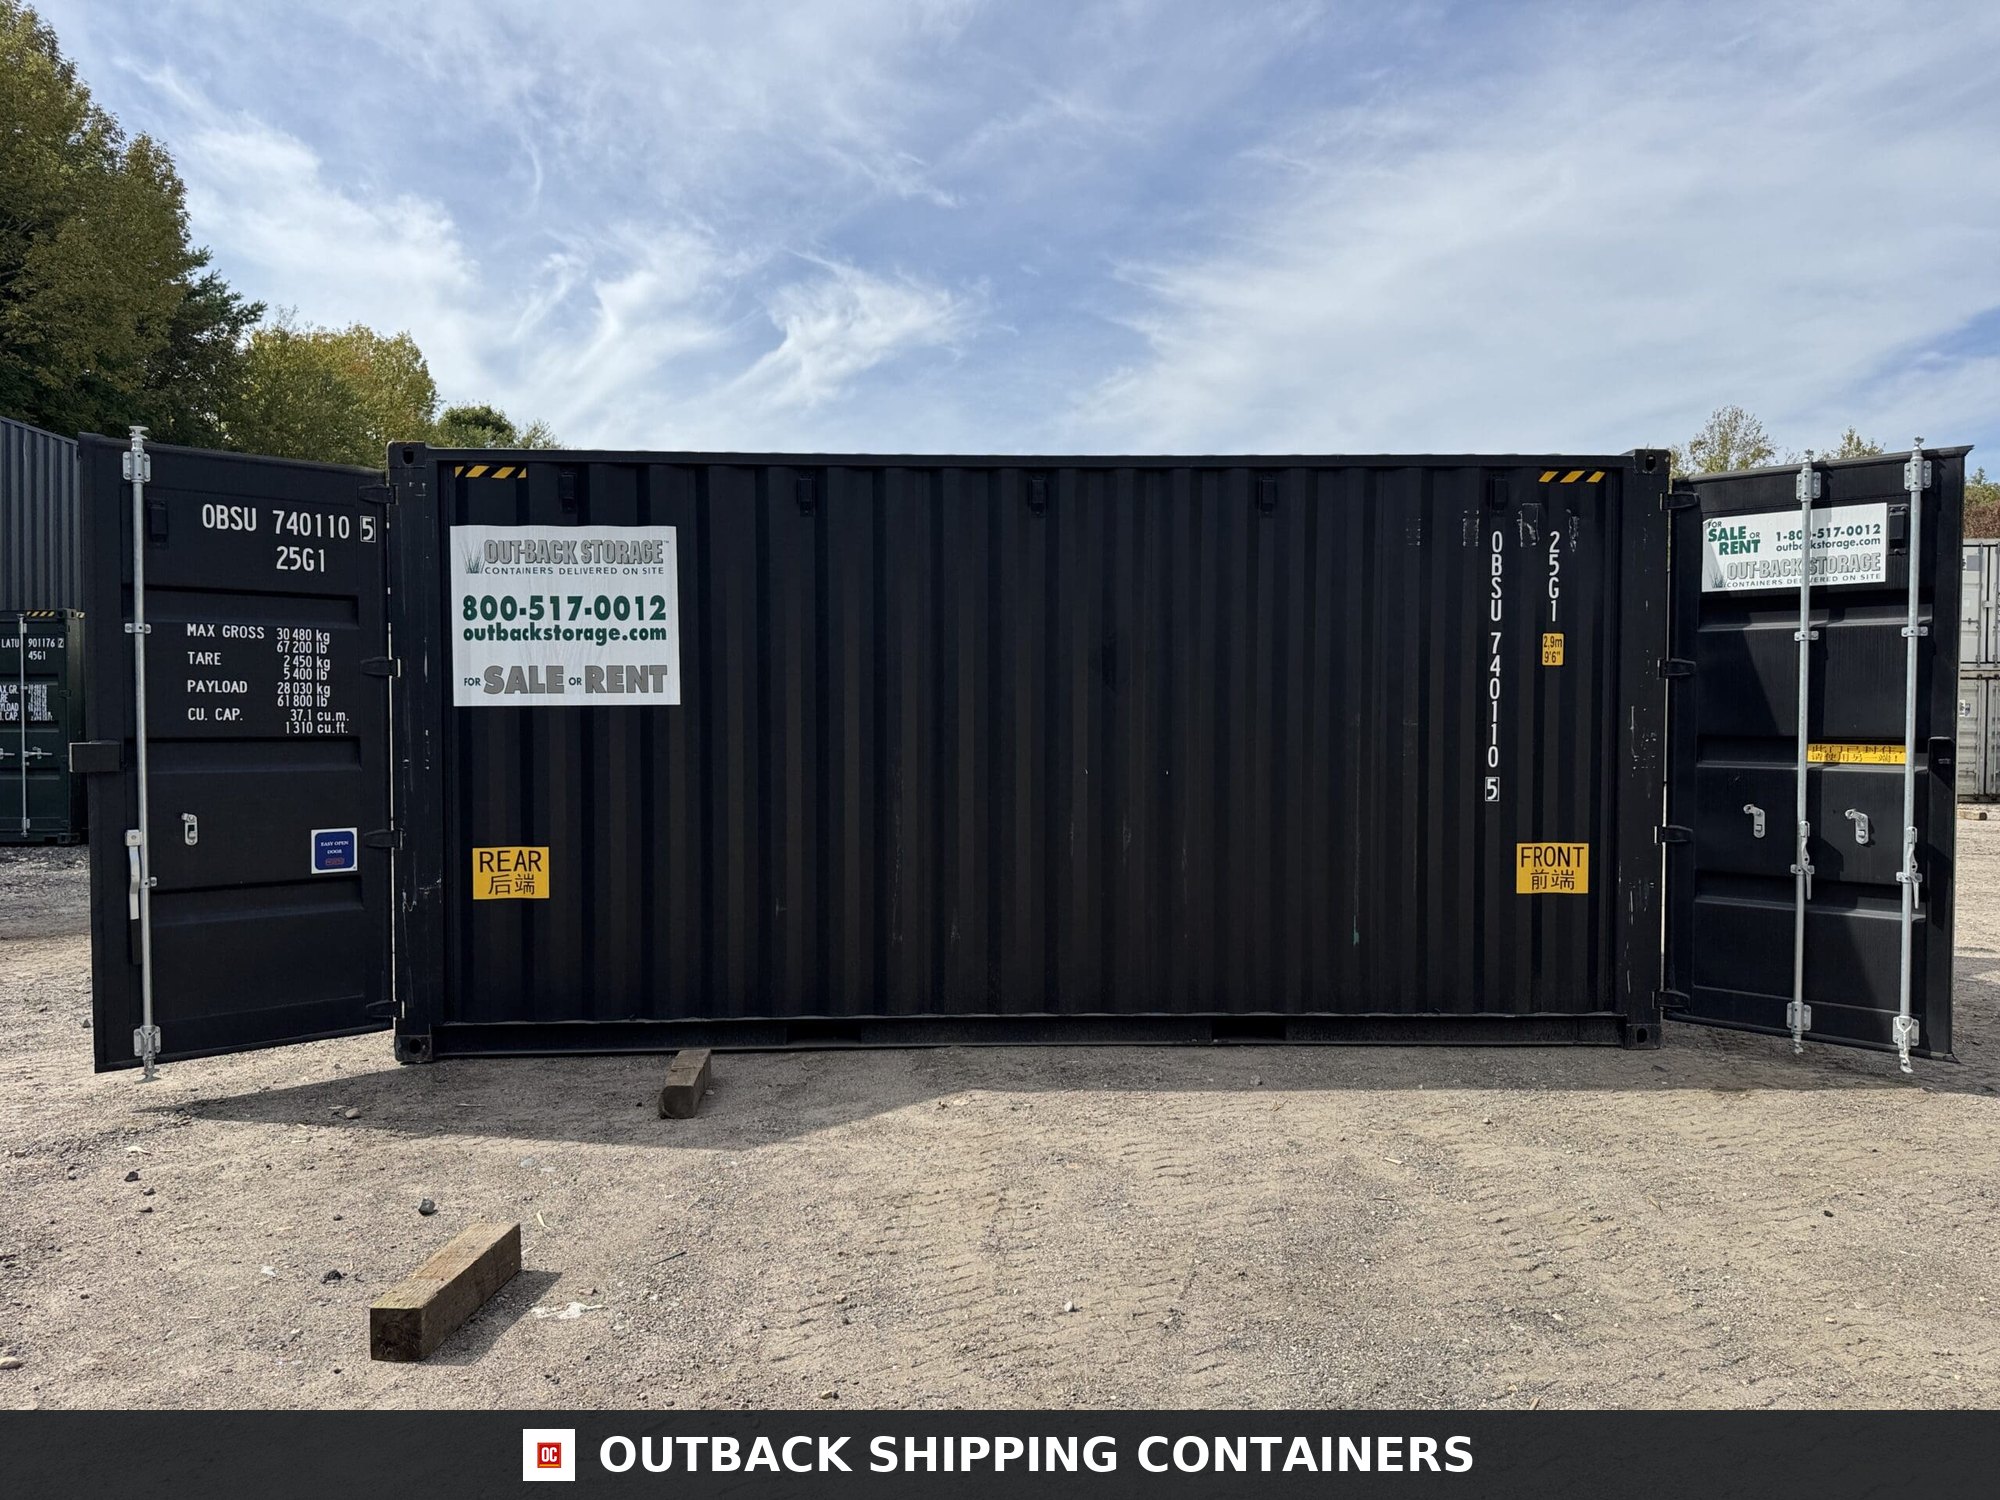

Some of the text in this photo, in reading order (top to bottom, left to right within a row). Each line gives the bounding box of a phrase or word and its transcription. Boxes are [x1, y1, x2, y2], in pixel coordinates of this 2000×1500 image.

[202, 504, 375, 542] OBSU 740110 5
[1776, 524, 1880, 541] 1-80-517-0012
[1708, 526, 1746, 542] SALE
[484, 540, 664, 565] OUT-BACK STORAGE
[1719, 539, 1761, 555] RENT
[276, 545, 325, 573] 25G1
[1808, 552, 1881, 575] STORAGE
[485, 567, 664, 575] CONTAINERS DELIVERED ON SITE
[1548, 530, 1560, 622] 25G1
[1727, 579, 1783, 588] CONTAINERS
[462, 595, 666, 621] 800-517-0012
[1, 638, 19, 648] LATU
[28, 638, 56, 648] 901176
[187, 623, 216, 637] MAX
[222, 625, 265, 639] GROSS
[316, 630, 330, 644] kg
[463, 622, 667, 646] outbackstorage.com
[28, 651, 46, 660] 45G1
[316, 642, 327, 654] lb
[187, 652, 221, 665] TARE
[316, 657, 330, 671] kg
[1486, 530, 1502, 801] OBSU 740110 5
[316, 668, 327, 681] lb
[464, 664, 668, 694] FOR SALE OR RENT
[187, 680, 248, 693] PAYLOAD
[316, 683, 330, 697] kg
[316, 695, 328, 707] lb
[187, 708, 349, 721] CU. CAP. 37.1 cu.m.
[317, 722, 348, 734] cu.ft.
[479, 850, 542, 873] REAR
[1521, 846, 1585, 868] FRONT
[488, 873, 535, 895] 后端
[1530, 869, 1575, 890] 前端
